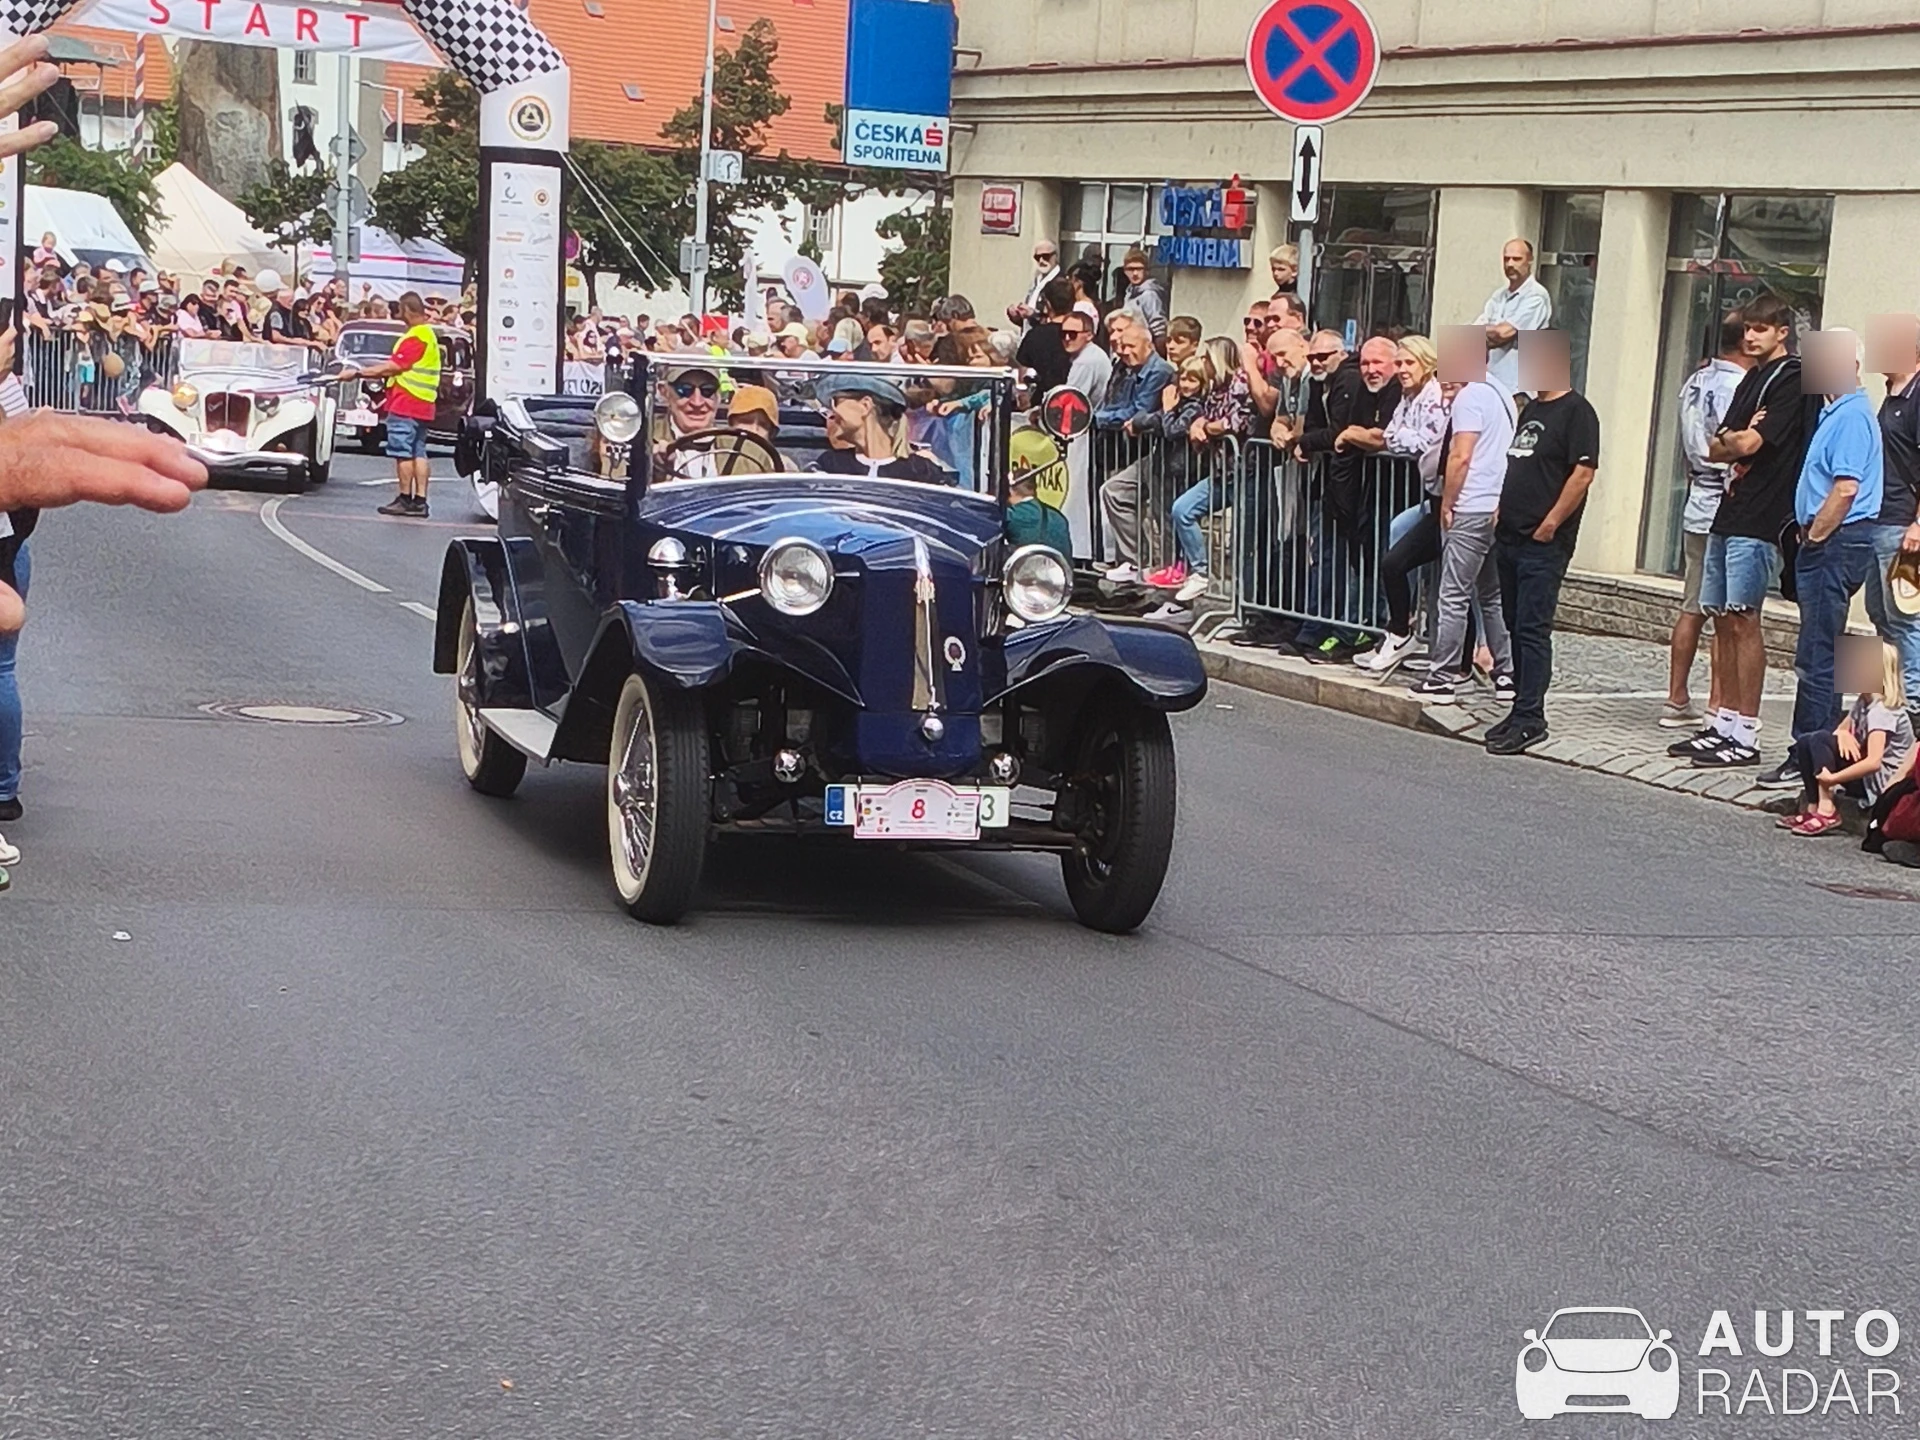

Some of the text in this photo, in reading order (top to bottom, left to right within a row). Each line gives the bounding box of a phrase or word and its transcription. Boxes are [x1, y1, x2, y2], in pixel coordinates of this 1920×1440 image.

[149, 0, 370, 47] START
[855, 119, 923, 145] ČESKÁ
[1038, 465, 1064, 492] NAK
[828, 810, 844, 821] CZ
[911, 798, 926, 819] 8
